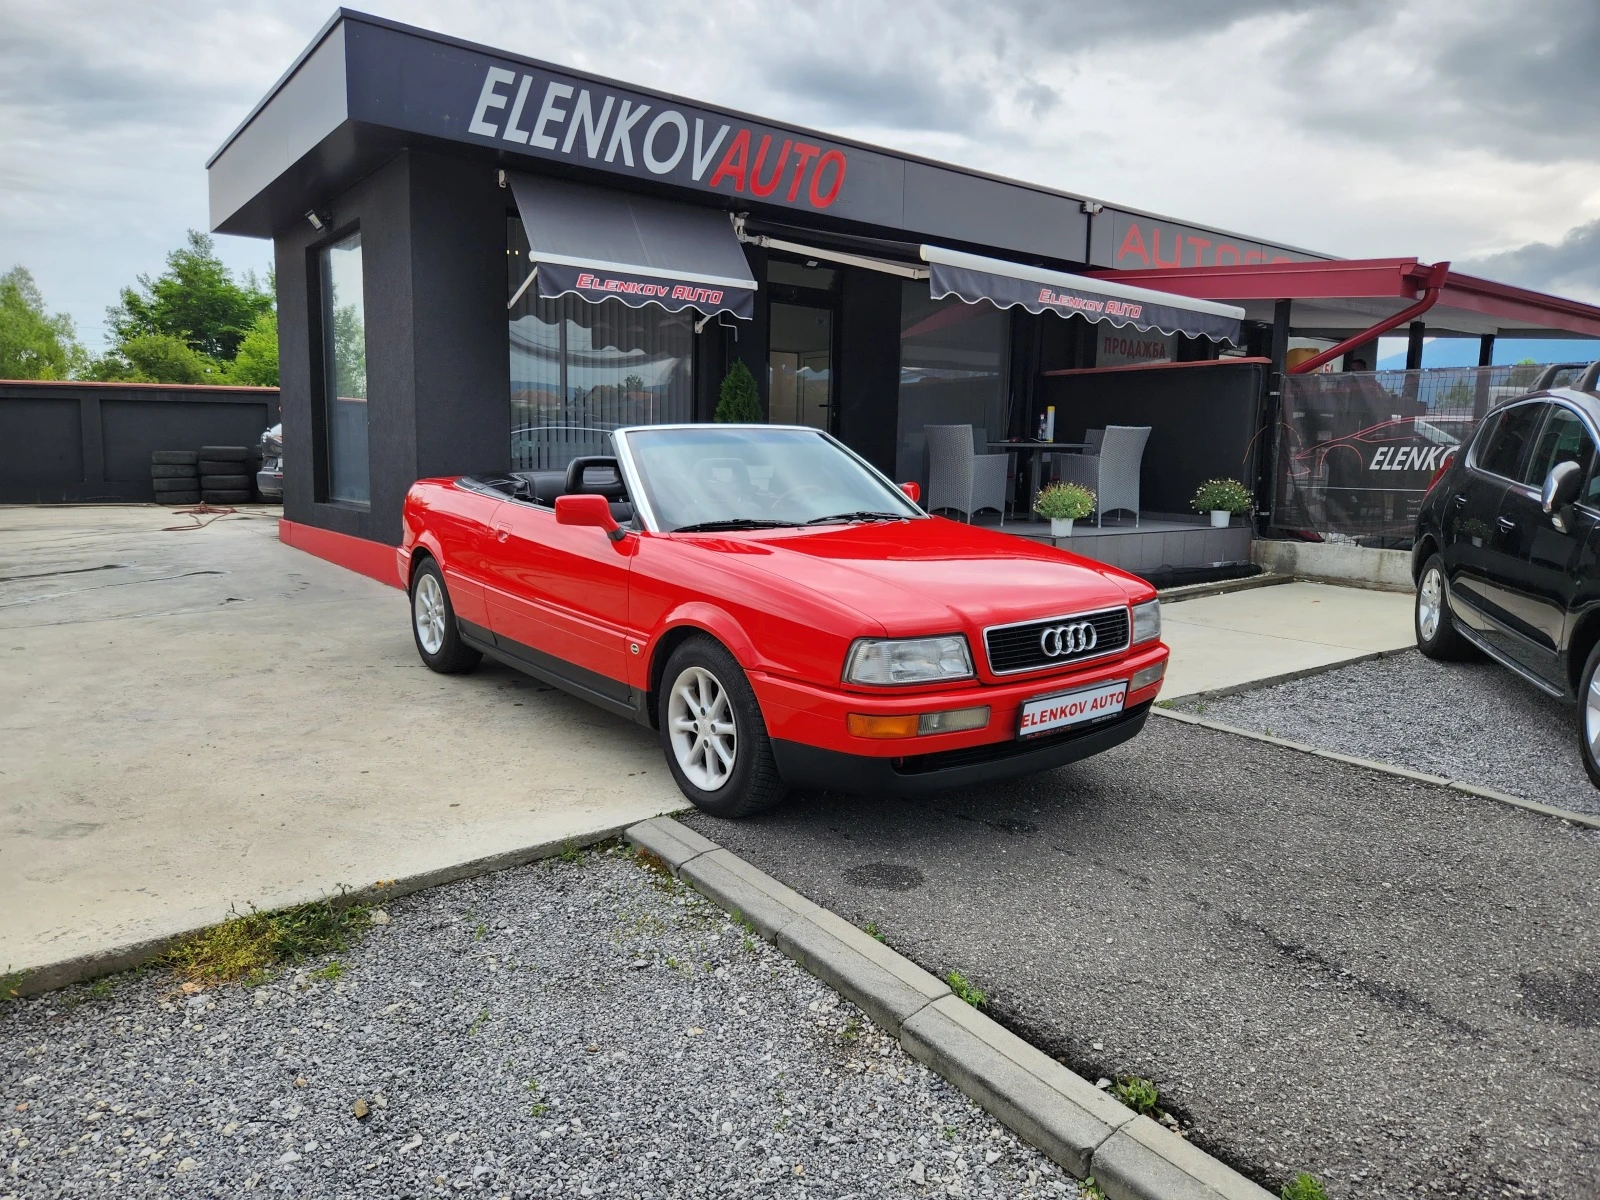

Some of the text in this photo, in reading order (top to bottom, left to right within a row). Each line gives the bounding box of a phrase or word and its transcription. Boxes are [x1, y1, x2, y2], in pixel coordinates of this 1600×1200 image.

[671, 285, 723, 305] AUTO
[1105, 300, 1142, 319] AUTO
[1103, 336, 1166, 359] ПРОДАЖБА
[1021, 700, 1087, 729] ELENKOV
[1090, 691, 1124, 712] AUTO
